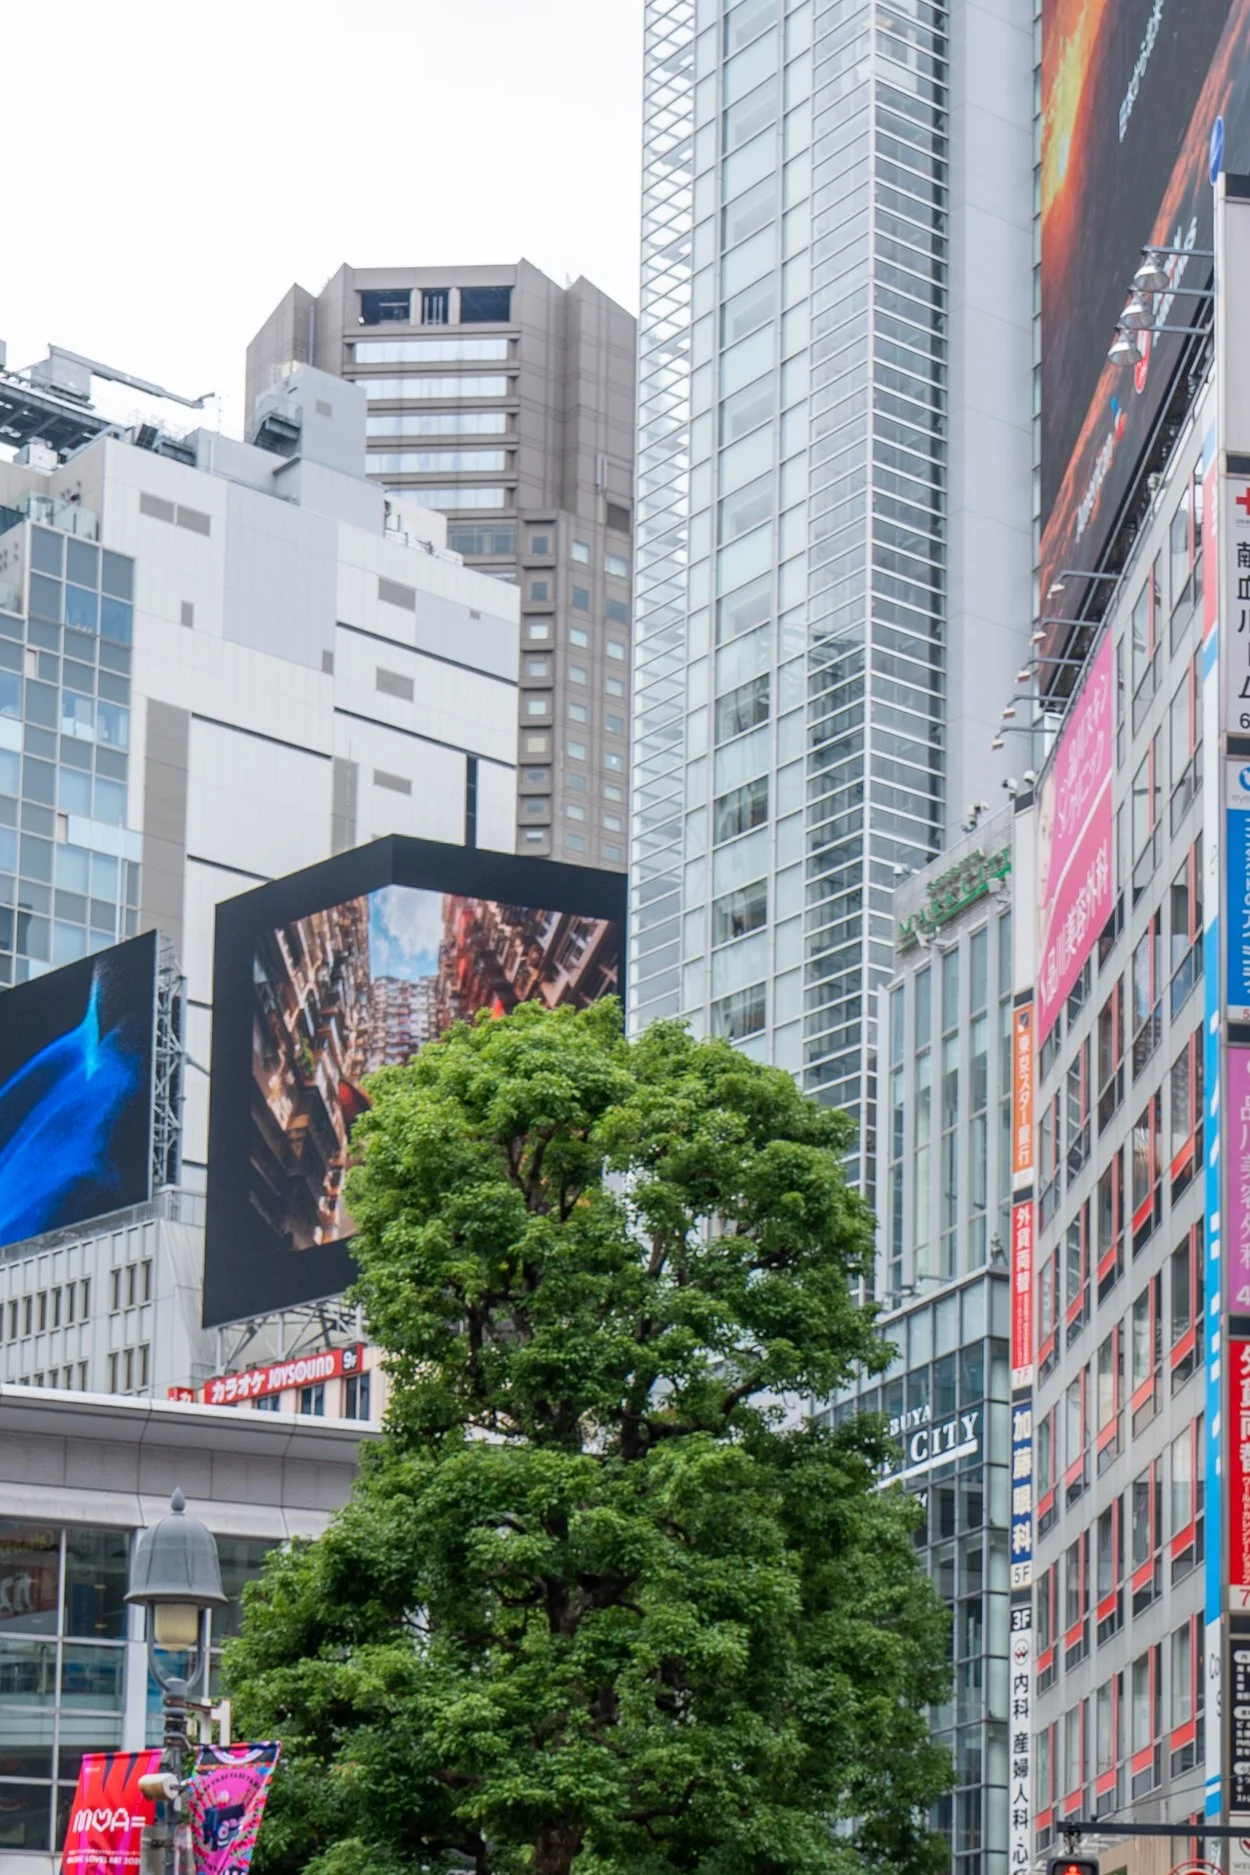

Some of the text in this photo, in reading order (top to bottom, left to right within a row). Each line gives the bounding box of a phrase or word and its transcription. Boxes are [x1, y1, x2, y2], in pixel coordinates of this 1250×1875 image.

[211, 1371, 266, 1404] カラオケ
[267, 1355, 335, 1389] JOYSOUND
[910, 1411, 979, 1462] CITY
[1013, 1409, 1032, 1555] 加藤眼科
[1014, 1562, 1030, 1584] 5F
[1013, 1611, 1030, 1629] 3F
[1013, 1673, 1030, 1719] 内科
